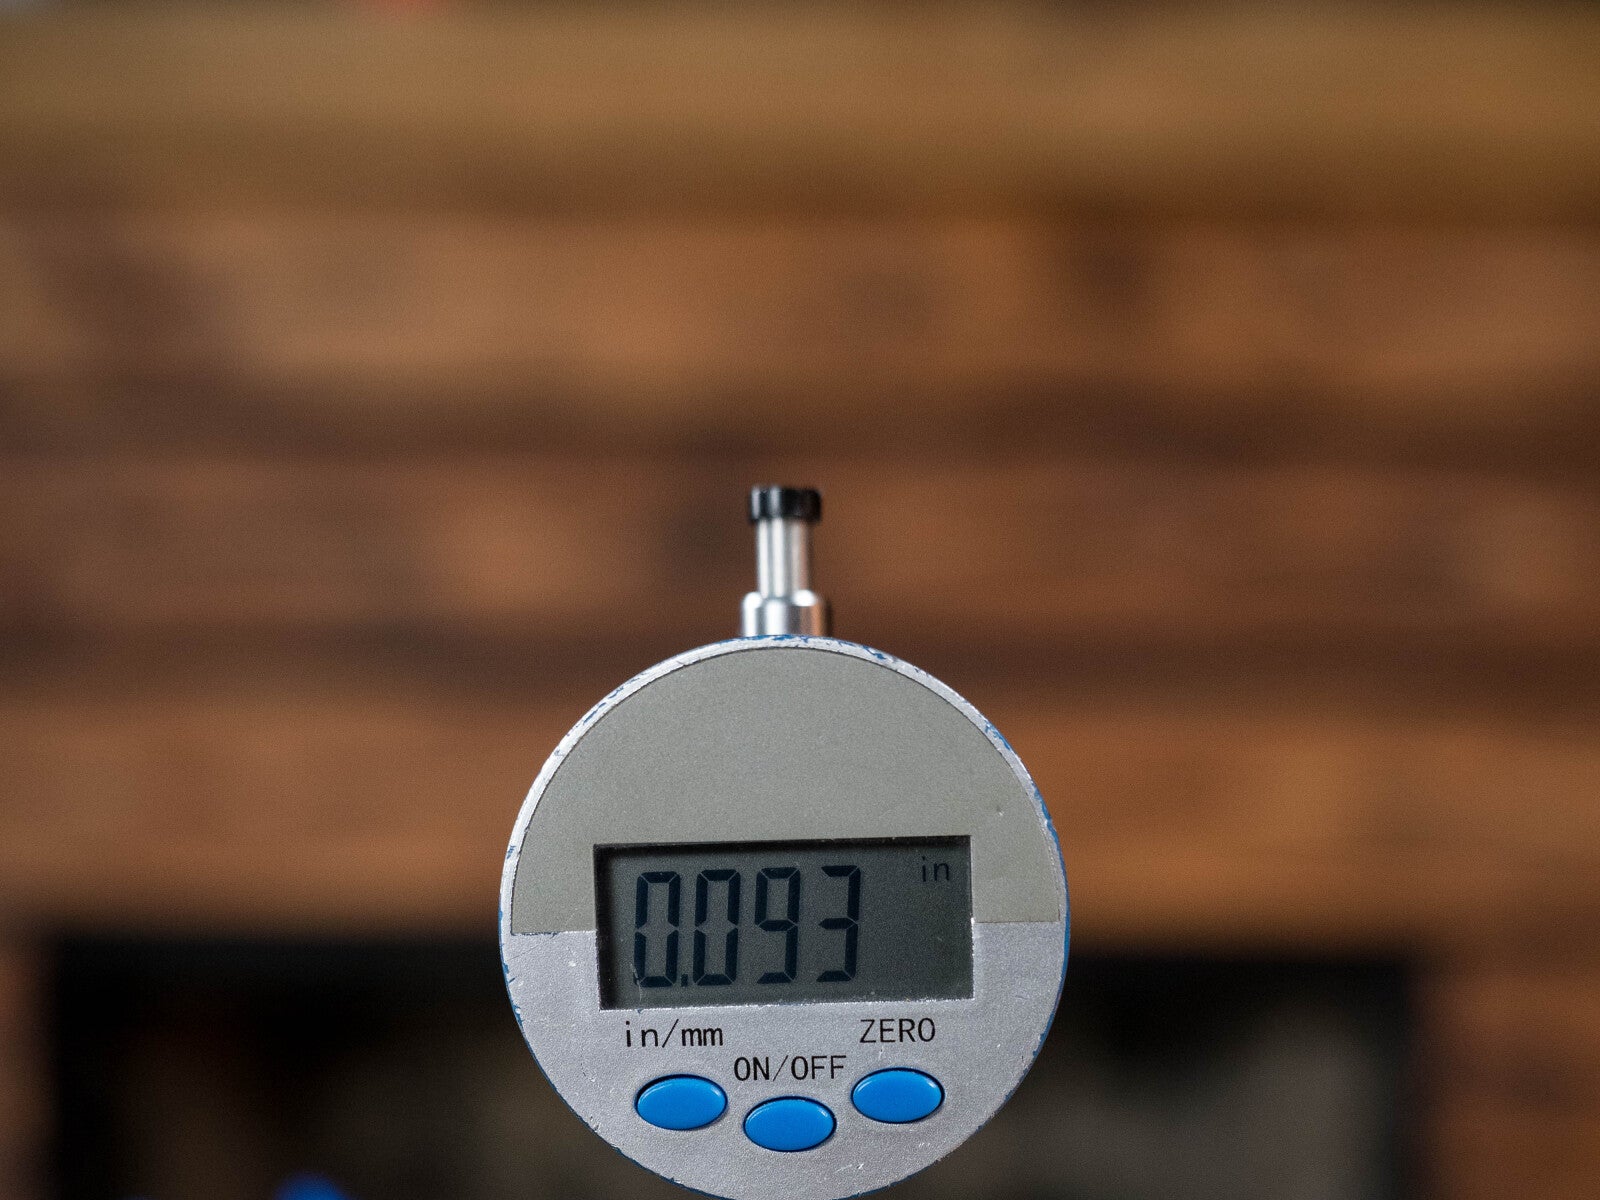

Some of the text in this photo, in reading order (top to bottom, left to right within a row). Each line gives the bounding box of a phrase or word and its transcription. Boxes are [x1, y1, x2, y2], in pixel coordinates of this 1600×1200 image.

[920, 858, 952, 883] in
[634, 866, 861, 988] 0.093
[625, 1019, 724, 1047] in/mm
[859, 1018, 937, 1044] ZERO
[733, 1055, 847, 1081] ON/OFF
